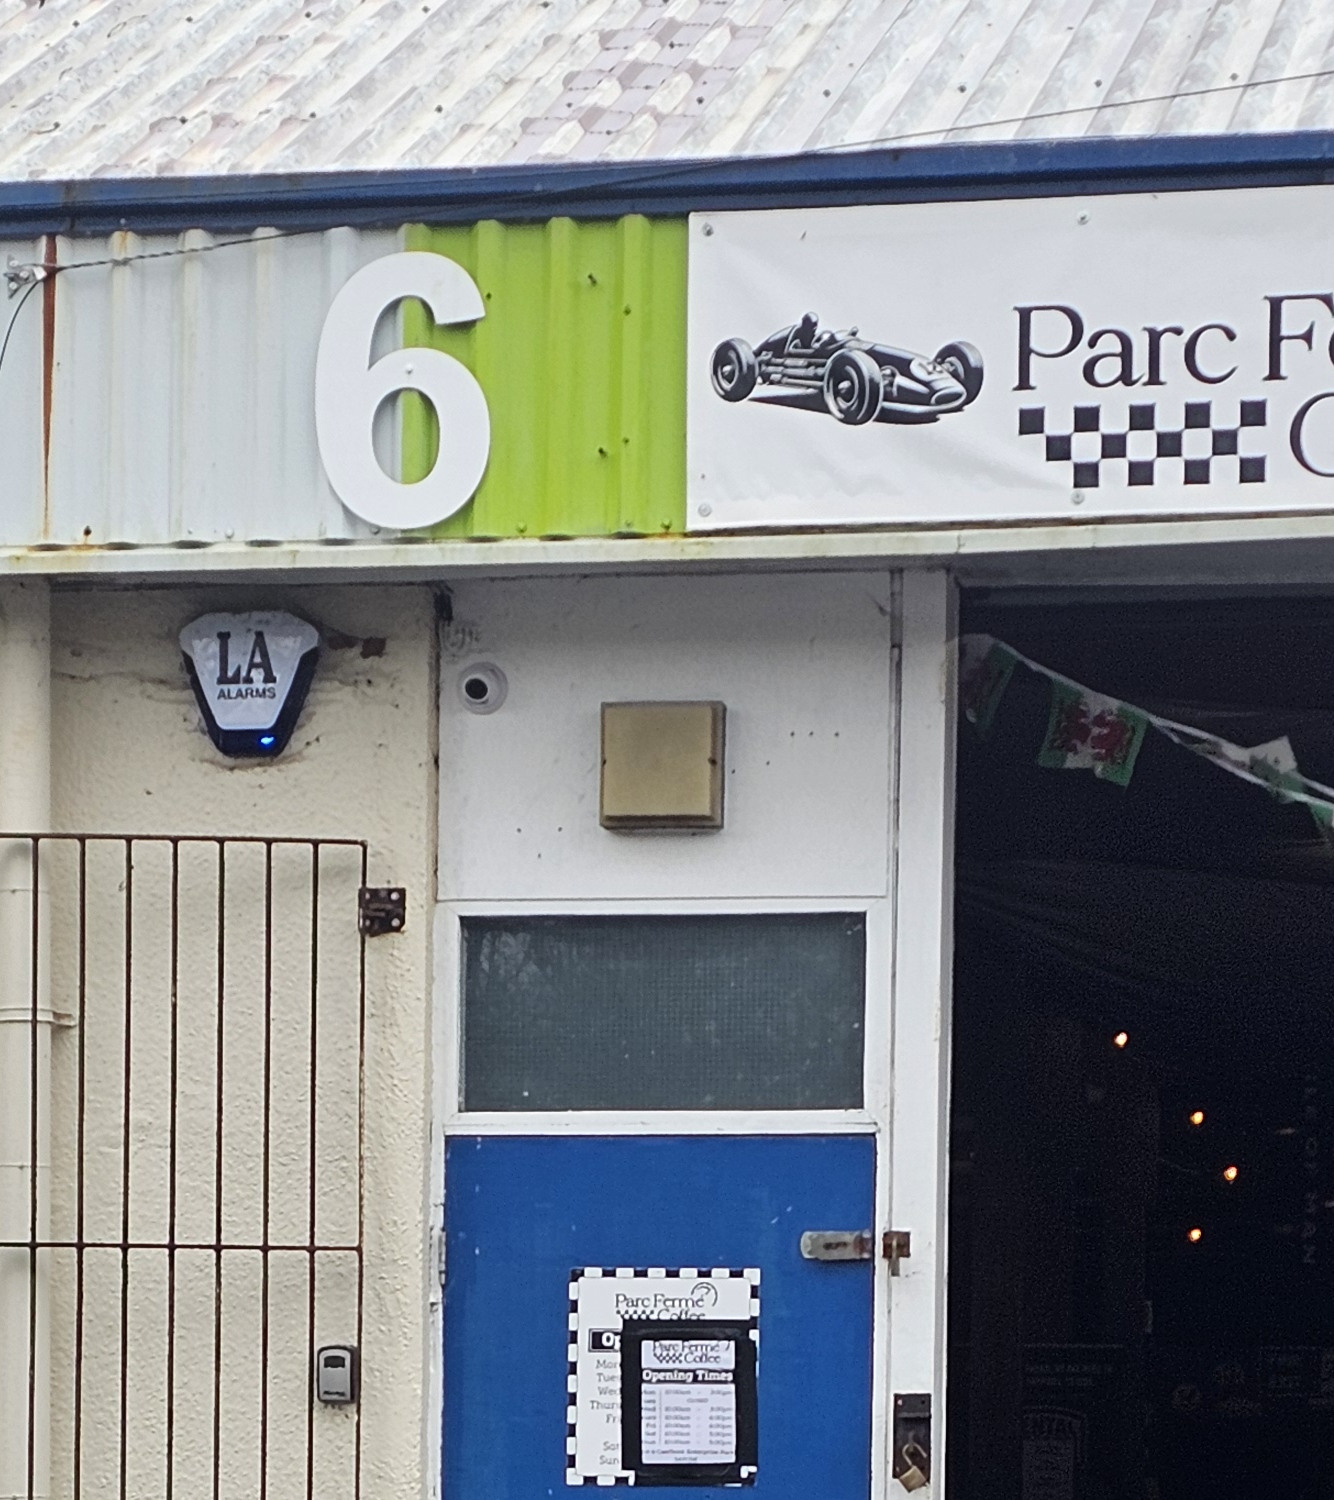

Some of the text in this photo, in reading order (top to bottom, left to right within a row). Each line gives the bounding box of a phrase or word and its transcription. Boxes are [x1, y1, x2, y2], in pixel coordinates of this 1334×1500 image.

[1013, 304, 1238, 391] Parc
[315, 251, 492, 529] 6
[216, 631, 277, 685] LA
[217, 687, 277, 700] ALARMS
[615, 1293, 650, 1309] Parc
[684, 1352, 721, 1364] Coffee
[642, 1369, 733, 1382] Opening Times
